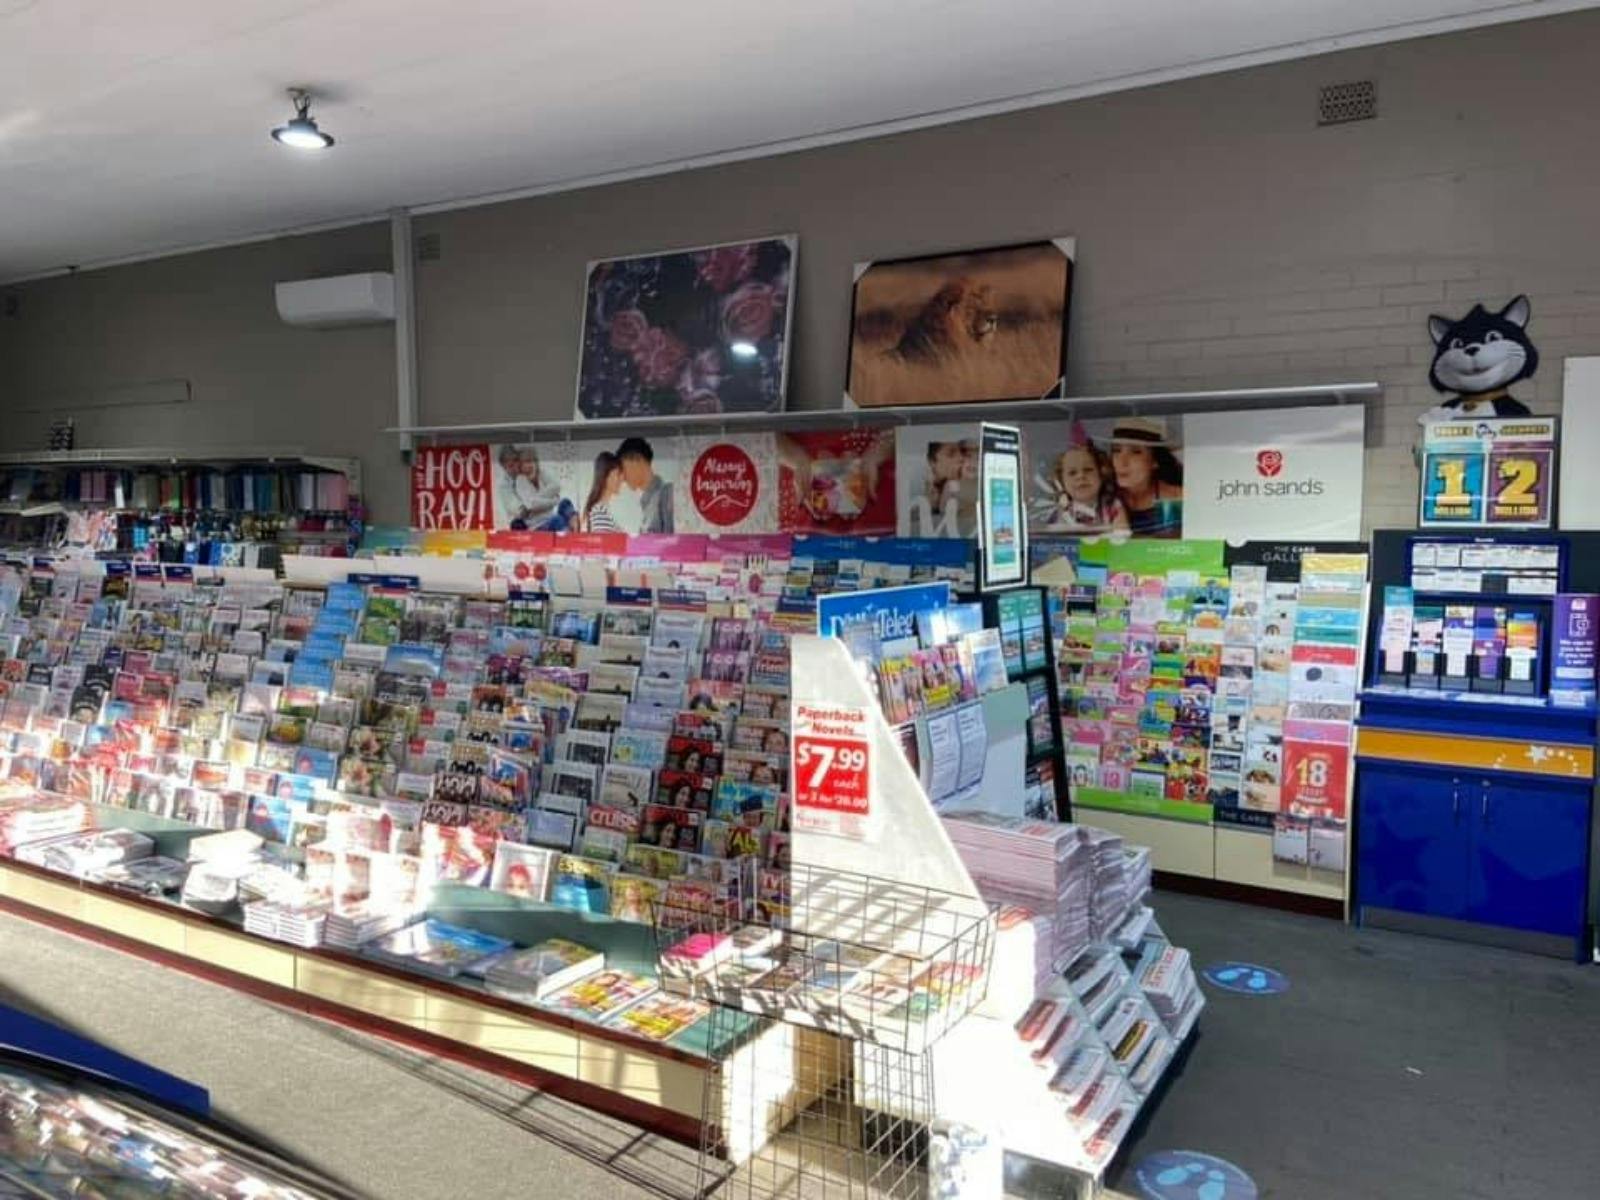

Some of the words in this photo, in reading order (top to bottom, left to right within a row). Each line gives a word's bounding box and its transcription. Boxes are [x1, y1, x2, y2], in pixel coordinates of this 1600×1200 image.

[426, 450, 486, 489] HOO
[1436, 461, 1470, 504] 1
[1498, 459, 1538, 504] 2
[1217, 479, 1259, 501] john
[1264, 478, 1325, 496] sands
[416, 488, 487, 530] RAY!
[1262, 551, 1301, 563] GALL
[875, 607, 915, 638] Teleg
[798, 706, 865, 722] Paperback
[811, 722, 855, 736] Novels
[796, 742, 867, 789] $7.99
[1296, 757, 1328, 788] 18
